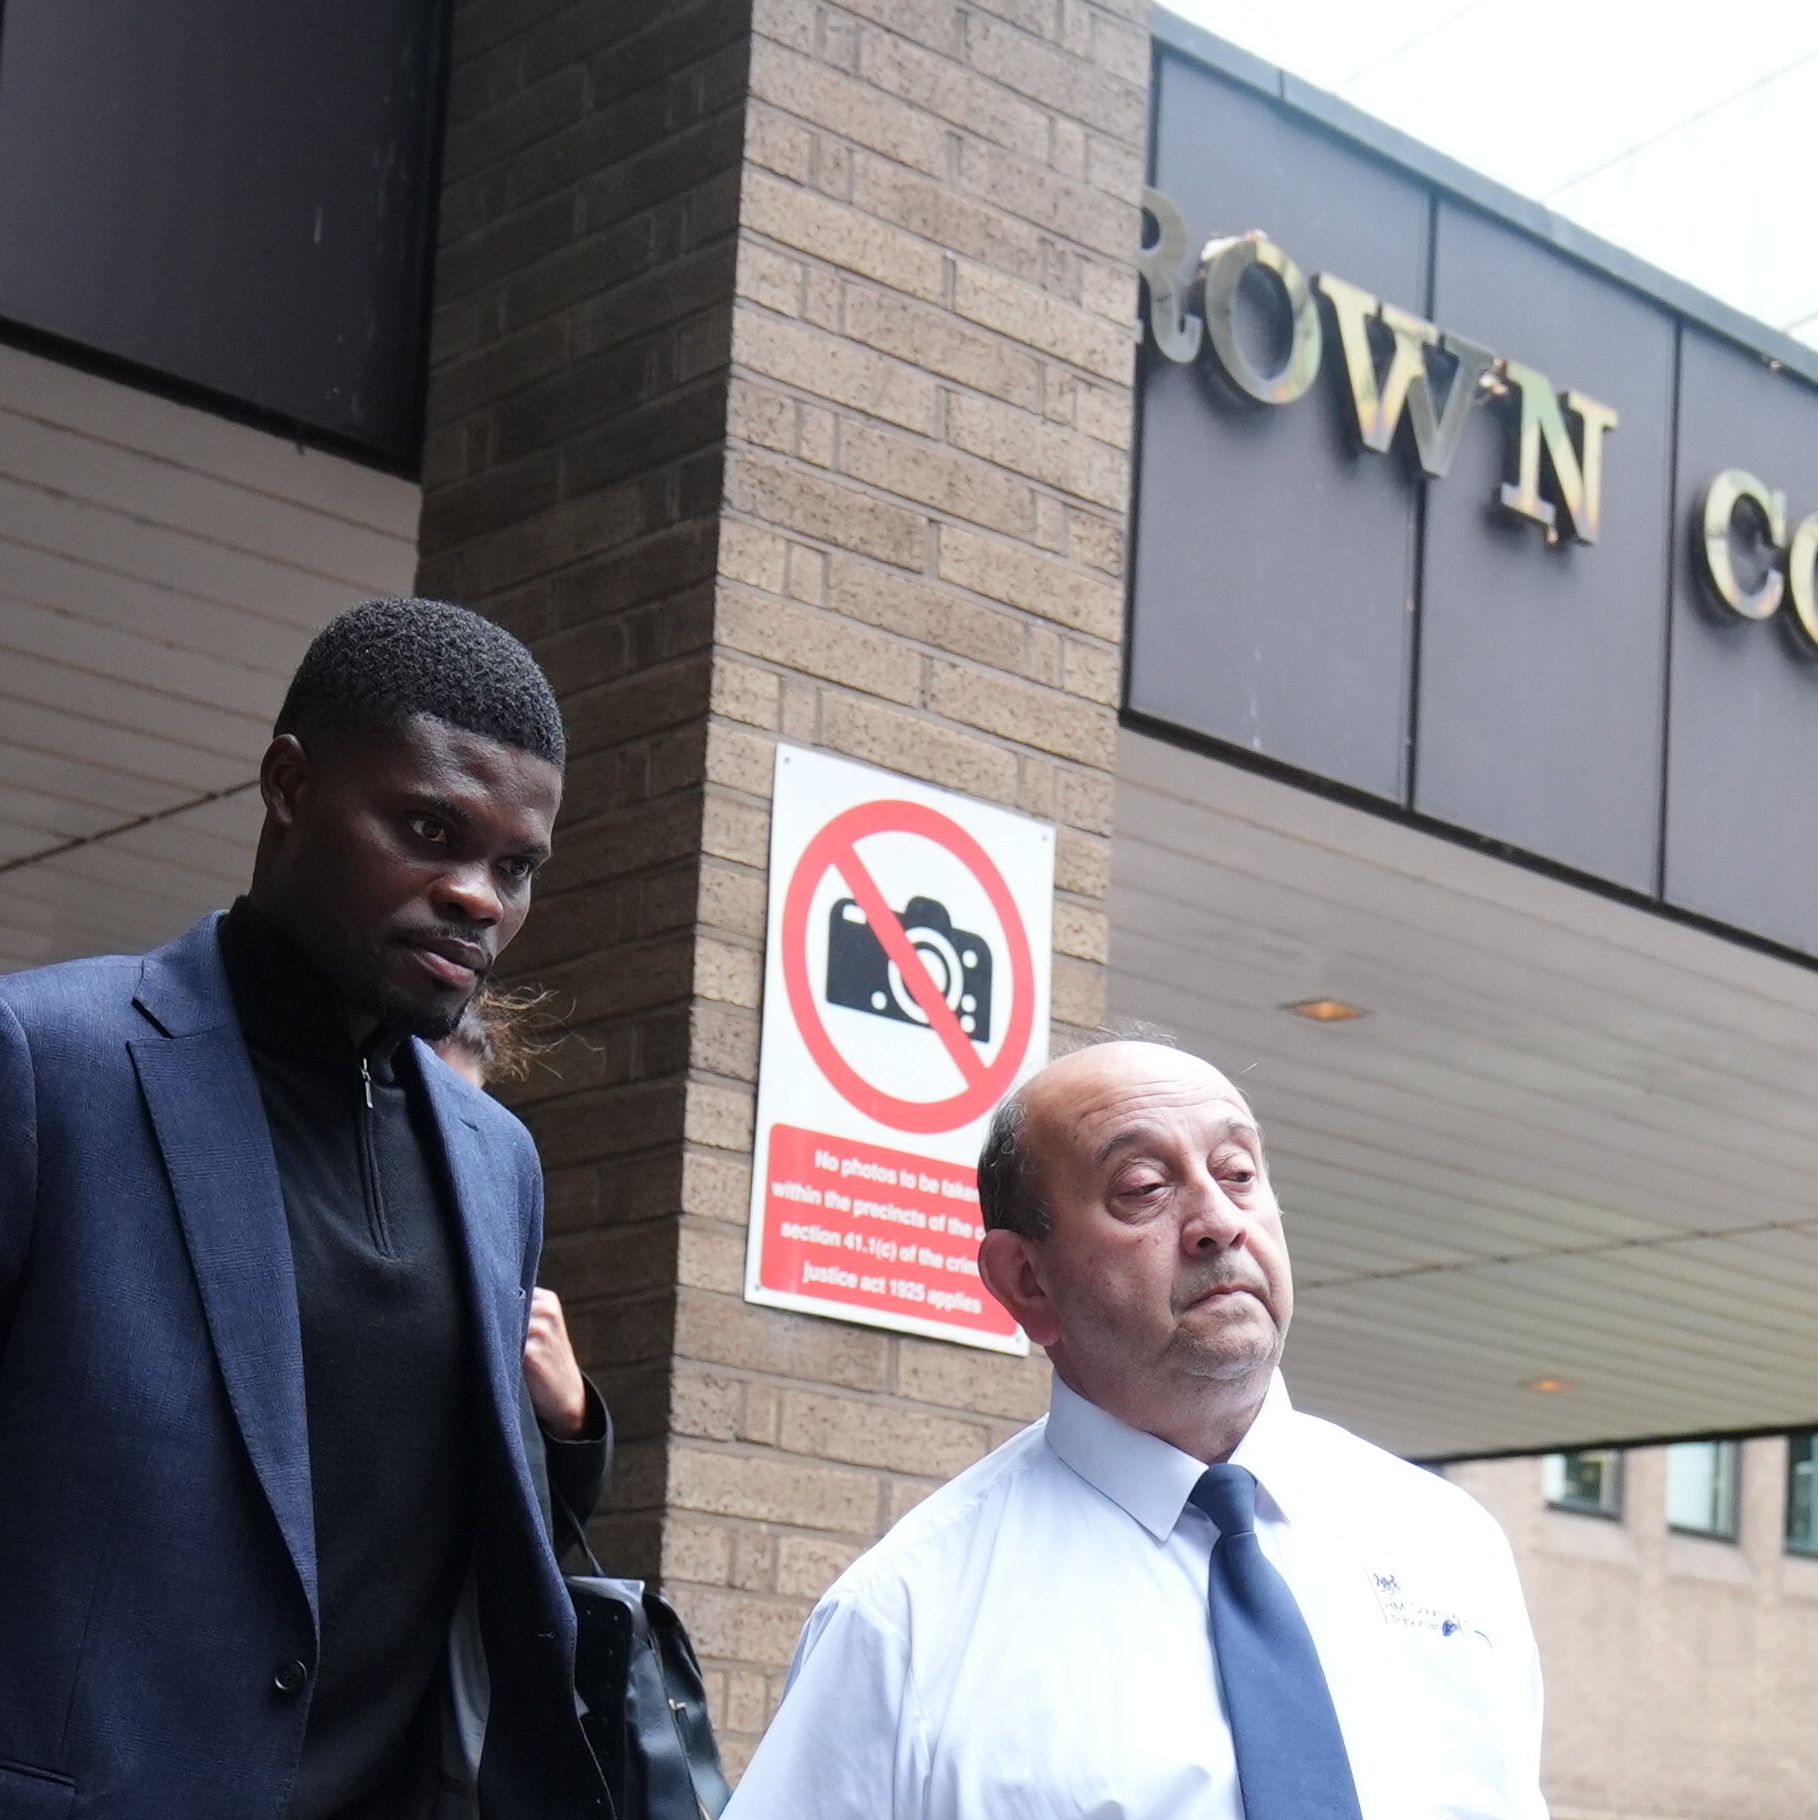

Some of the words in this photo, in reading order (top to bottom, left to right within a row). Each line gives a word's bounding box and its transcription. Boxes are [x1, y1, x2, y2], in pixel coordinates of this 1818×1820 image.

[814, 1149, 840, 1171] No
[841, 1157, 897, 1184] photos
[899, 1168, 917, 1189] to
[918, 1171, 940, 1194] be
[771, 1181, 822, 1206] within
[824, 1190, 851, 1212] the
[852, 1199, 927, 1229] precincts
[928, 1213, 946, 1232] of
[947, 1216, 973, 1239] the
[781, 1221, 841, 1248] section
[899, 1244, 917, 1263] of
[918, 1247, 944, 1269] the
[803, 1260, 857, 1289] justice
[860, 1275, 886, 1295] act
[889, 1278, 926, 1303] 1925
[926, 1288, 982, 1315] applies
